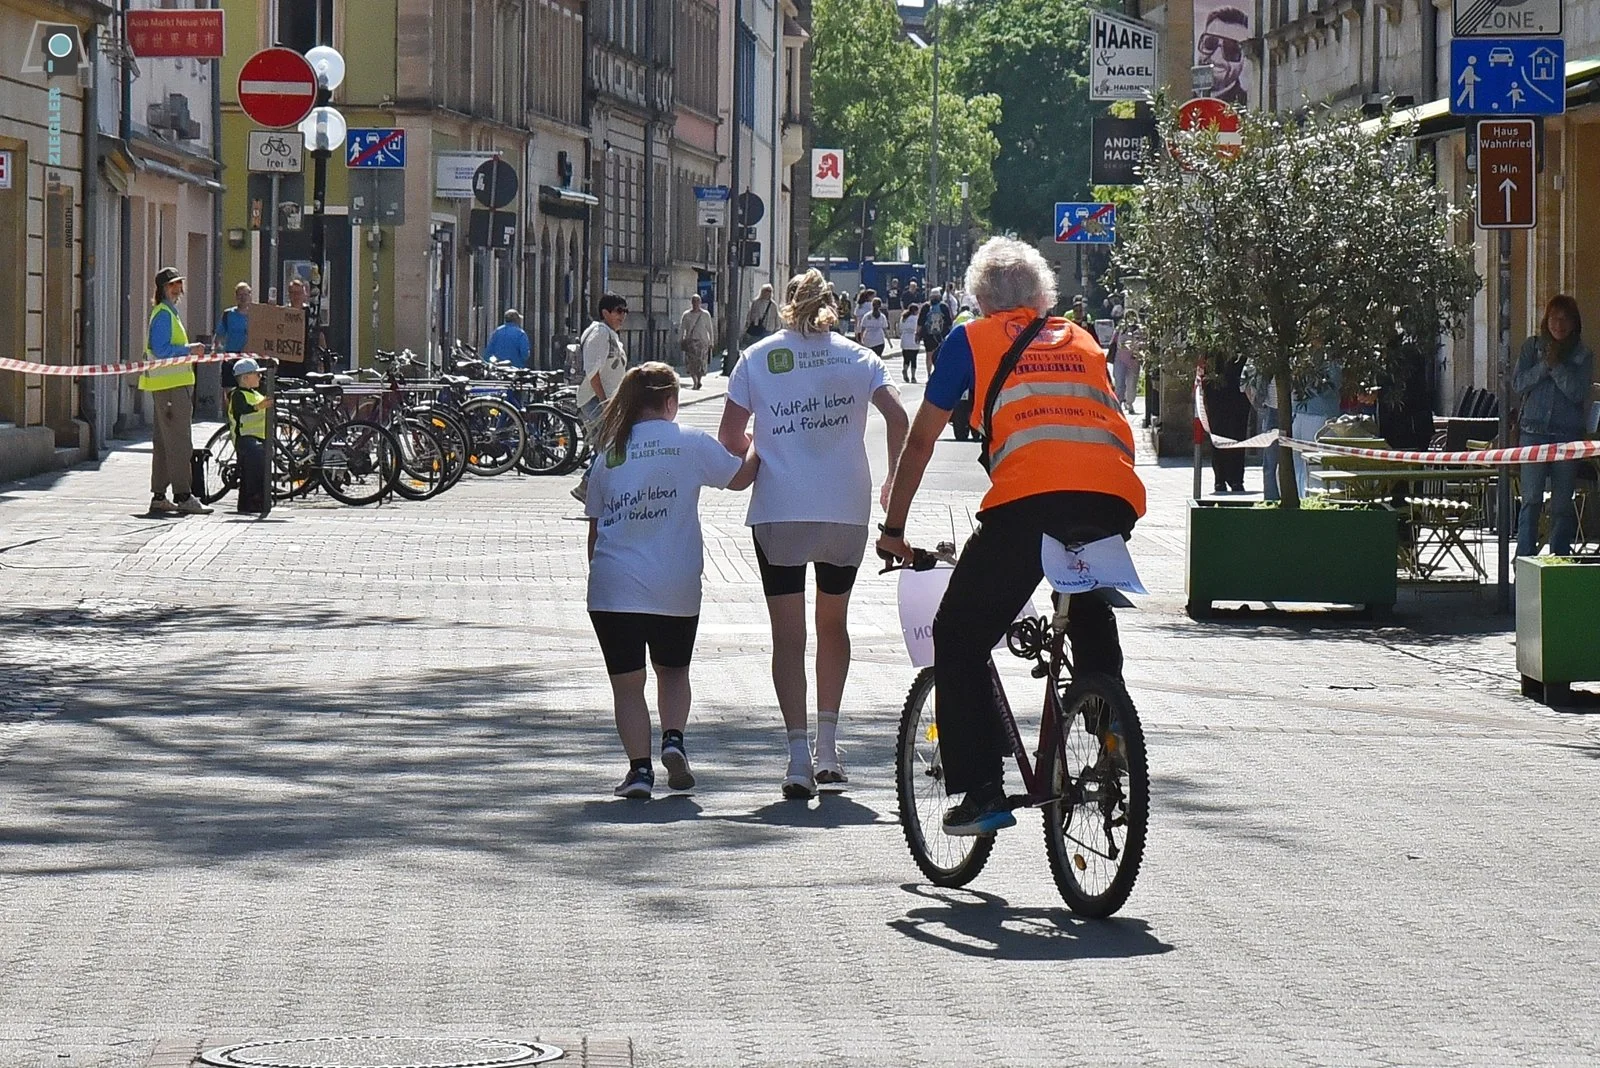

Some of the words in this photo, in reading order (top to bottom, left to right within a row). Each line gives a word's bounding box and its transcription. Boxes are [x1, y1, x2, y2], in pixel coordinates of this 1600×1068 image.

[150, 17, 175, 27] Markt
[176, 17, 199, 27] Neue
[1481, 11, 1535, 28] ZONE
[1096, 18, 1153, 49] HAARE
[1097, 50, 1116, 66] &
[1107, 64, 1153, 77] NÄGEL
[1493, 126, 1519, 137] Haus
[1480, 138, 1532, 149] Wahnfried
[1104, 150, 1142, 160] HAGE
[266, 157, 284, 168] frei
[1491, 164, 1498, 174] 3
[770, 398, 818, 417] Vielfalt
[825, 393, 855, 409] leben
[772, 423, 796, 435] und
[800, 414, 849, 430] fördern
[648, 486, 677, 501] leben
[624, 507, 668, 520] ördern
